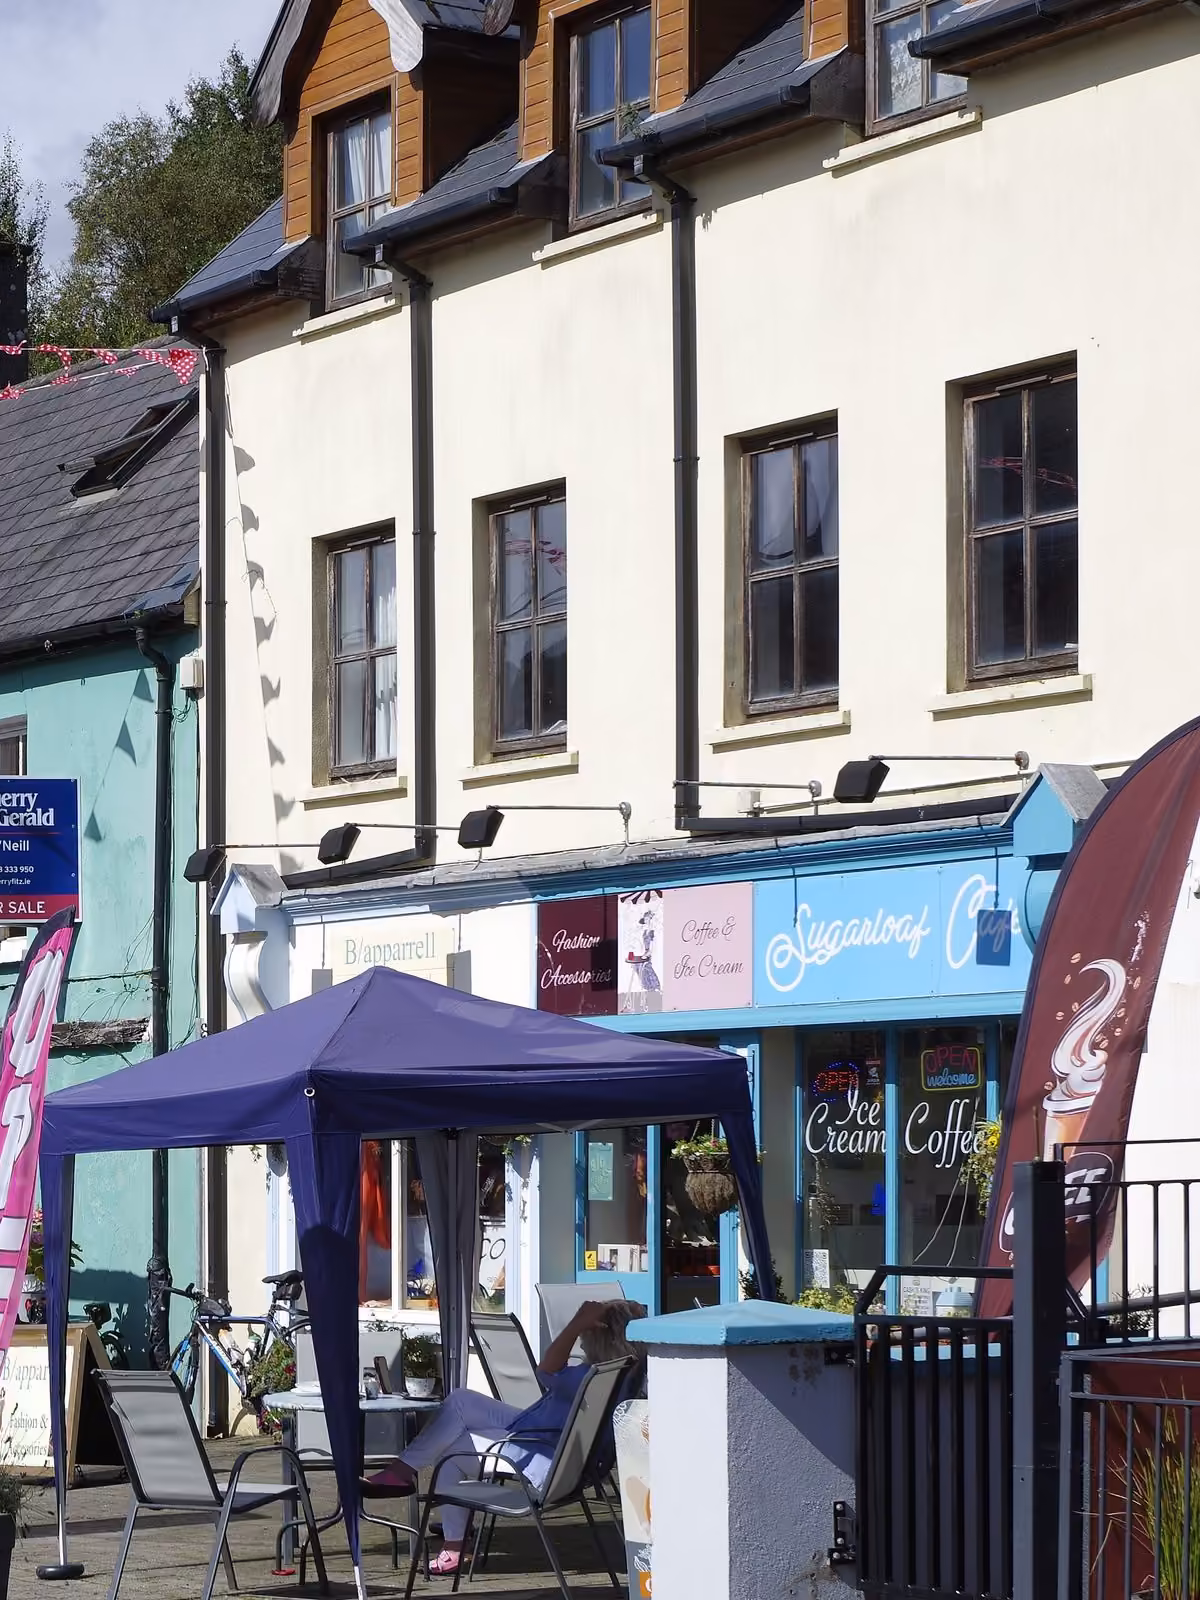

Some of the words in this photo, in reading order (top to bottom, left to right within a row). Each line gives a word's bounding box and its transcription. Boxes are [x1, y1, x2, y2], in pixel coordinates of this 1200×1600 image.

[8, 901, 46, 914] SALE
[552, 929, 601, 953] Fashion
[681, 919, 720, 945] Coffee
[721, 916, 737, 941] &
[765, 903, 931, 992] Sugarloaf
[540, 964, 612, 989] Accessories
[674, 954, 695, 980] Ice
[698, 954, 744, 978] Cream
[925, 1045, 976, 1073] OPEN
[815, 1071, 858, 1092] OPEN
[927, 1068, 975, 1087] welcome
[835, 1077, 881, 1126] Ice
[805, 1102, 887, 1154] Cream
[905, 1099, 982, 1168] Coffee
